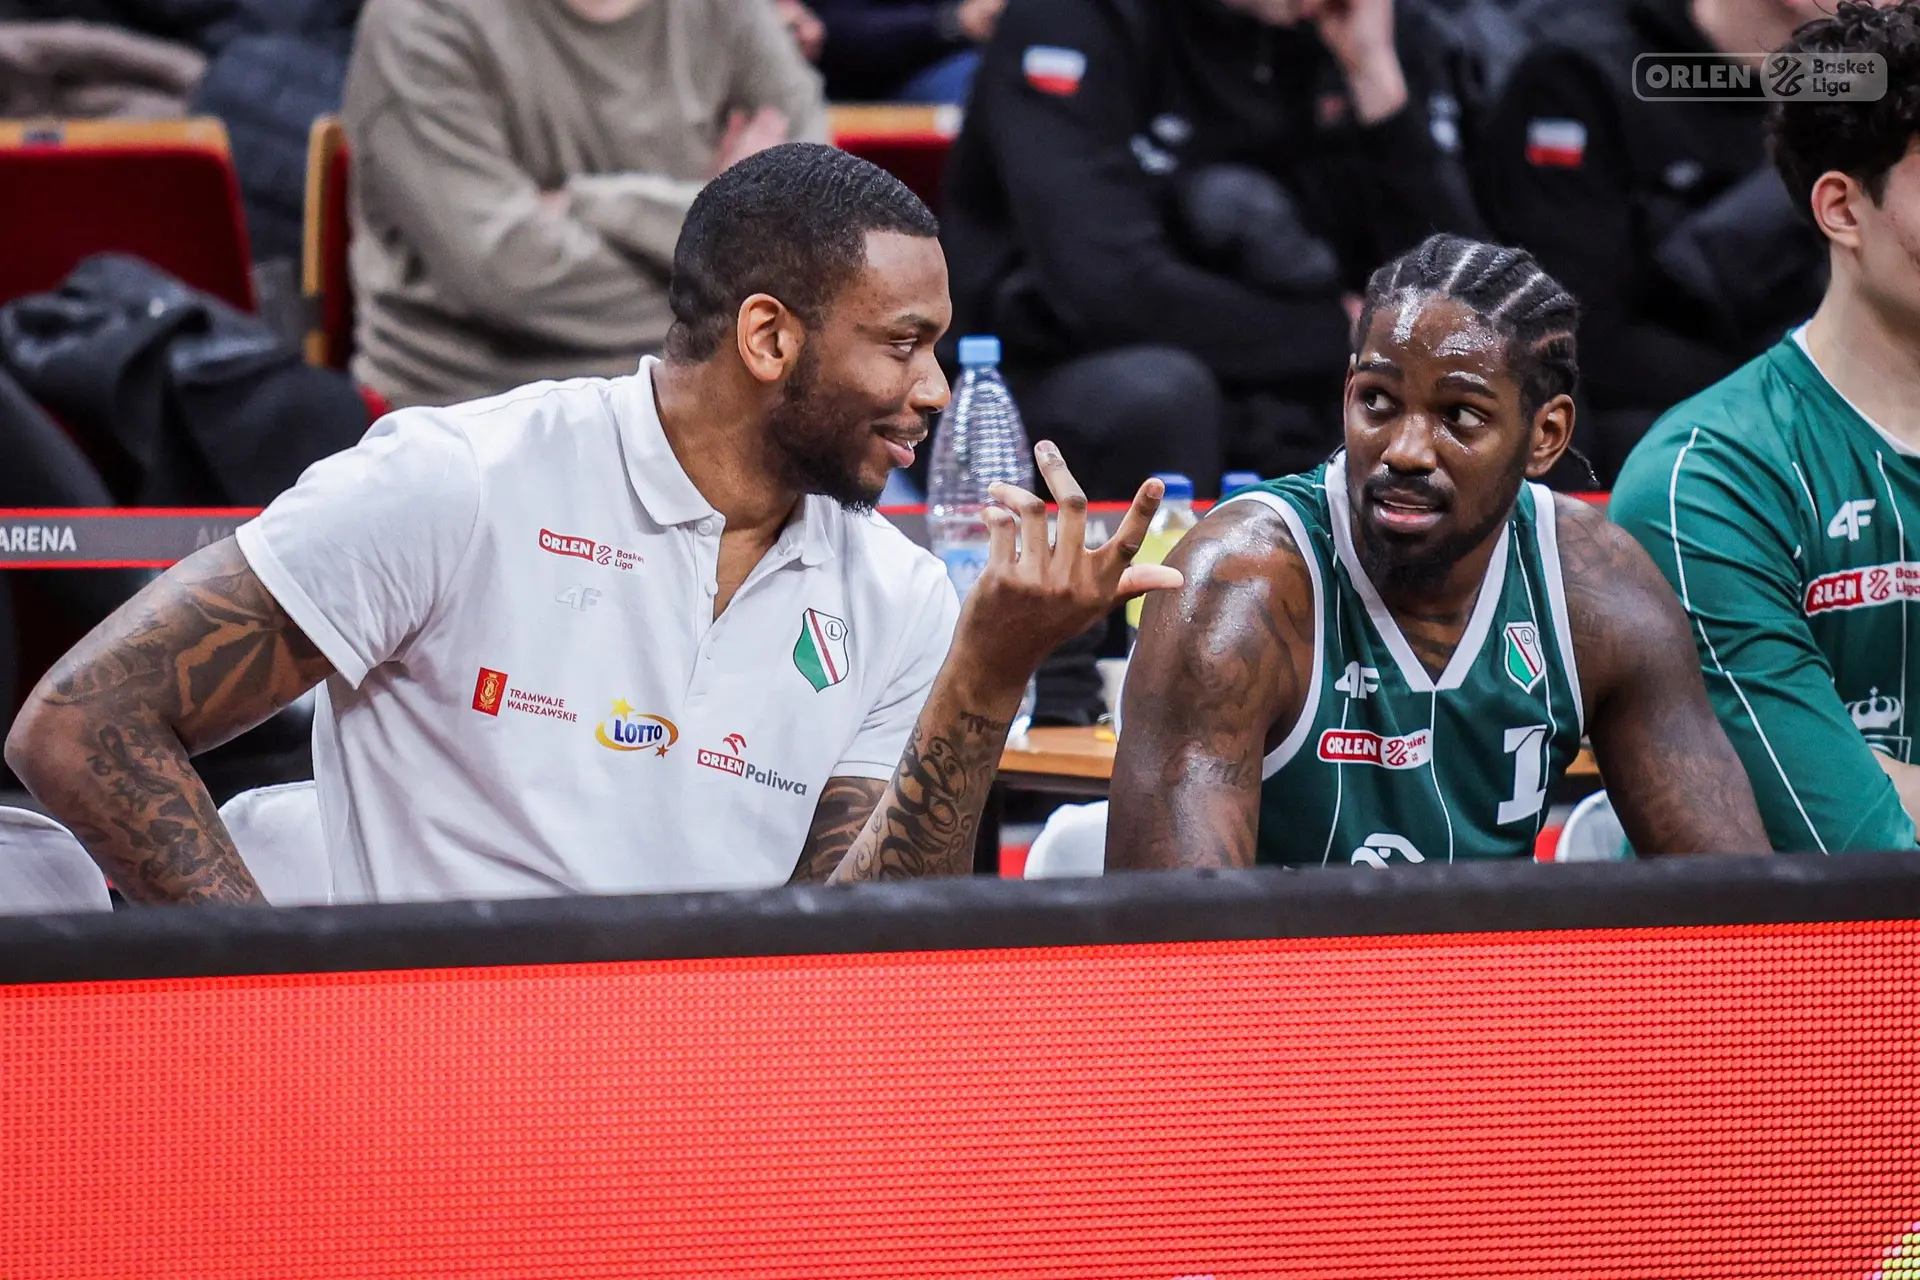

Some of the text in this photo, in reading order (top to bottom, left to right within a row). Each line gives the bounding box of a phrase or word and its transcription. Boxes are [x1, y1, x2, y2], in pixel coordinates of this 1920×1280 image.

[1827, 498, 1877, 542] 4F
[0, 525, 77, 552] ARENA
[541, 533, 591, 556] ORLEN
[614, 558, 634, 571] Liga
[555, 583, 602, 612] 4F
[1812, 578, 1858, 606] RLEN
[1334, 660, 1380, 700] 4F
[506, 699, 578, 723] WARSZAWSKIE
[509, 688, 565, 708] TRAMWAJE
[613, 719, 663, 744] LOTTO
[1325, 736, 1378, 757] ORLEN
[700, 752, 808, 796] ORLEN Paliwa
[1496, 723, 1548, 826] 1
